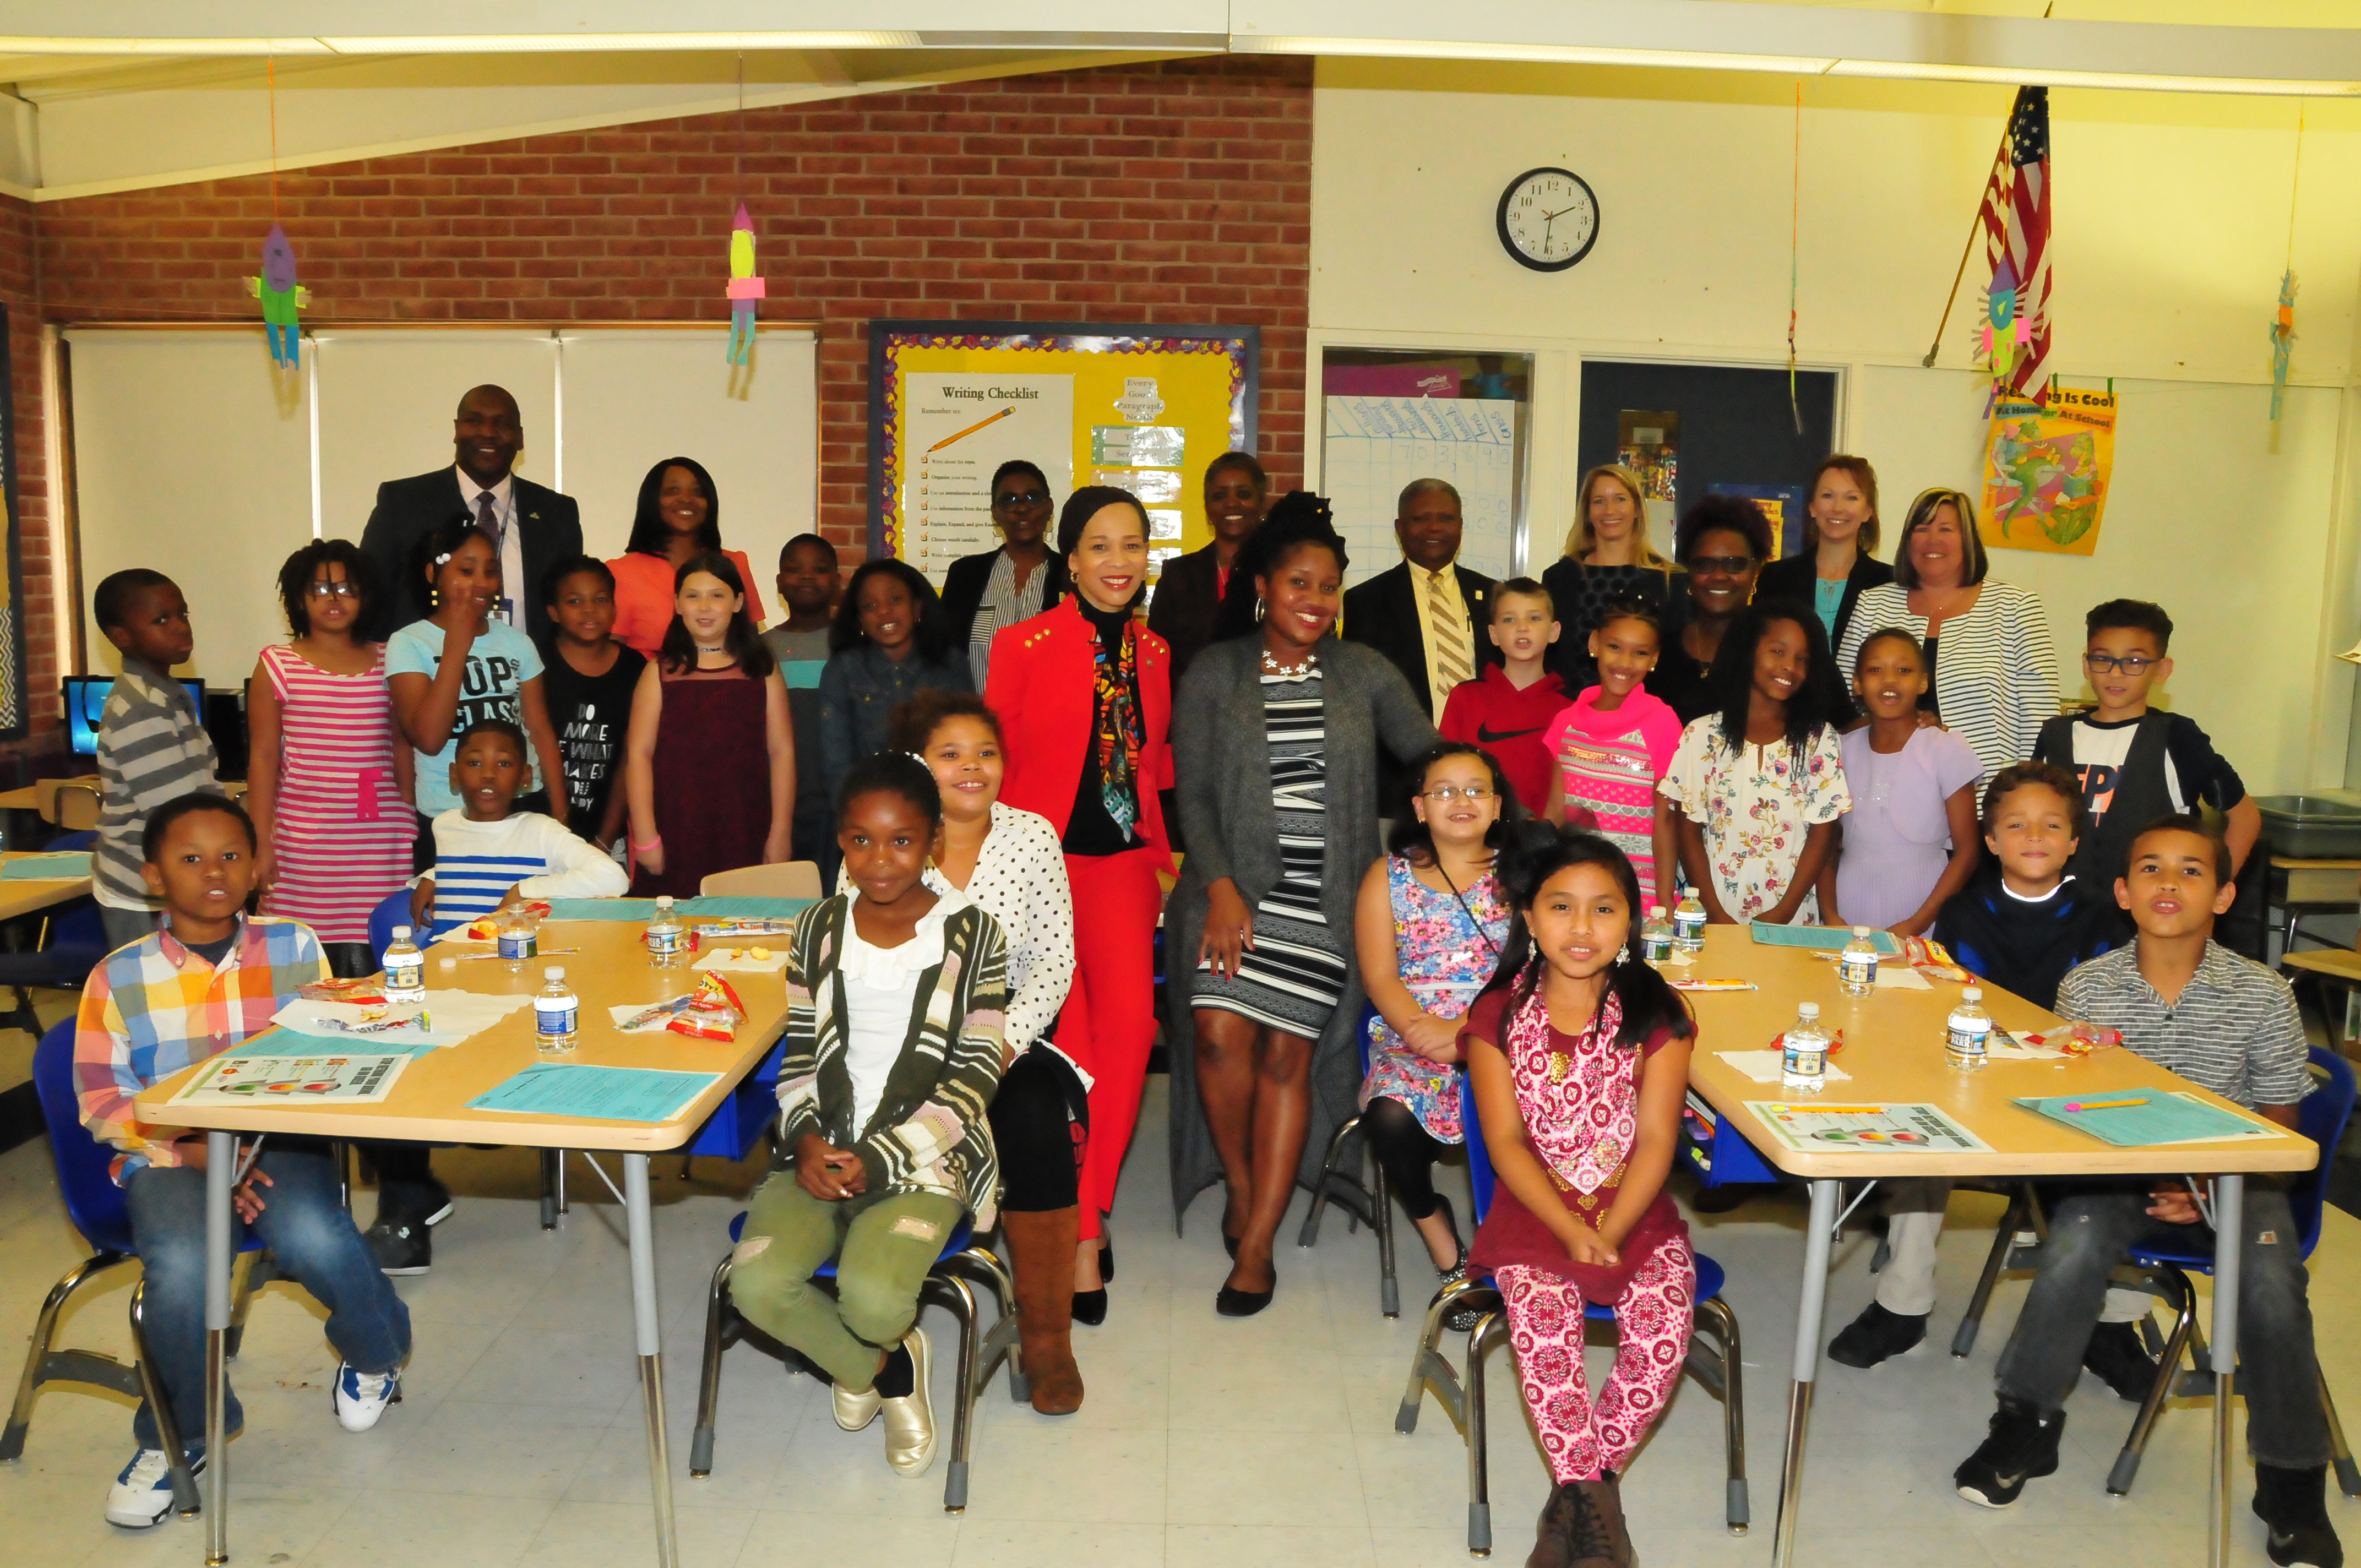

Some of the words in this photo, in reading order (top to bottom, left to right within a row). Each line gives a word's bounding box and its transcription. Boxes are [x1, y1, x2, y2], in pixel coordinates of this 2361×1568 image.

[1532, 185, 1542, 195] 11
[1548, 181, 1559, 191] 12
[1568, 187, 1571, 197] 1
[1521, 197, 1532, 206] 10
[1578, 200, 1584, 210] 2
[1514, 212, 1520, 221] 9
[1580, 216, 1587, 225] 3
[1518, 228, 1525, 237] 8
[1575, 231, 1581, 240] 4
[1531, 240, 1536, 251] 7
[1547, 246, 1553, 255] 6
[1562, 242, 1569, 252] 5
[942, 386, 984, 401] Writing
[988, 387, 1039, 400] Checklist
[1998, 385, 2063, 404] Reang
[2065, 393, 2079, 404] Is
[2082, 394, 2114, 407] Cool
[1117, 402, 1163, 412] Paragraph
[2012, 406, 2043, 414] Home
[2059, 410, 2073, 420] At
[2075, 413, 2110, 428] School
[1470, 412, 1487, 437] tens
[1490, 411, 1511, 438] ones
[578, 704, 595, 720] DO
[564, 722, 608, 741] MORE
[571, 742, 613, 760] WHAT
[1951, 1032, 1971, 1042] DEER
[1950, 1038, 1970, 1047] PARK
